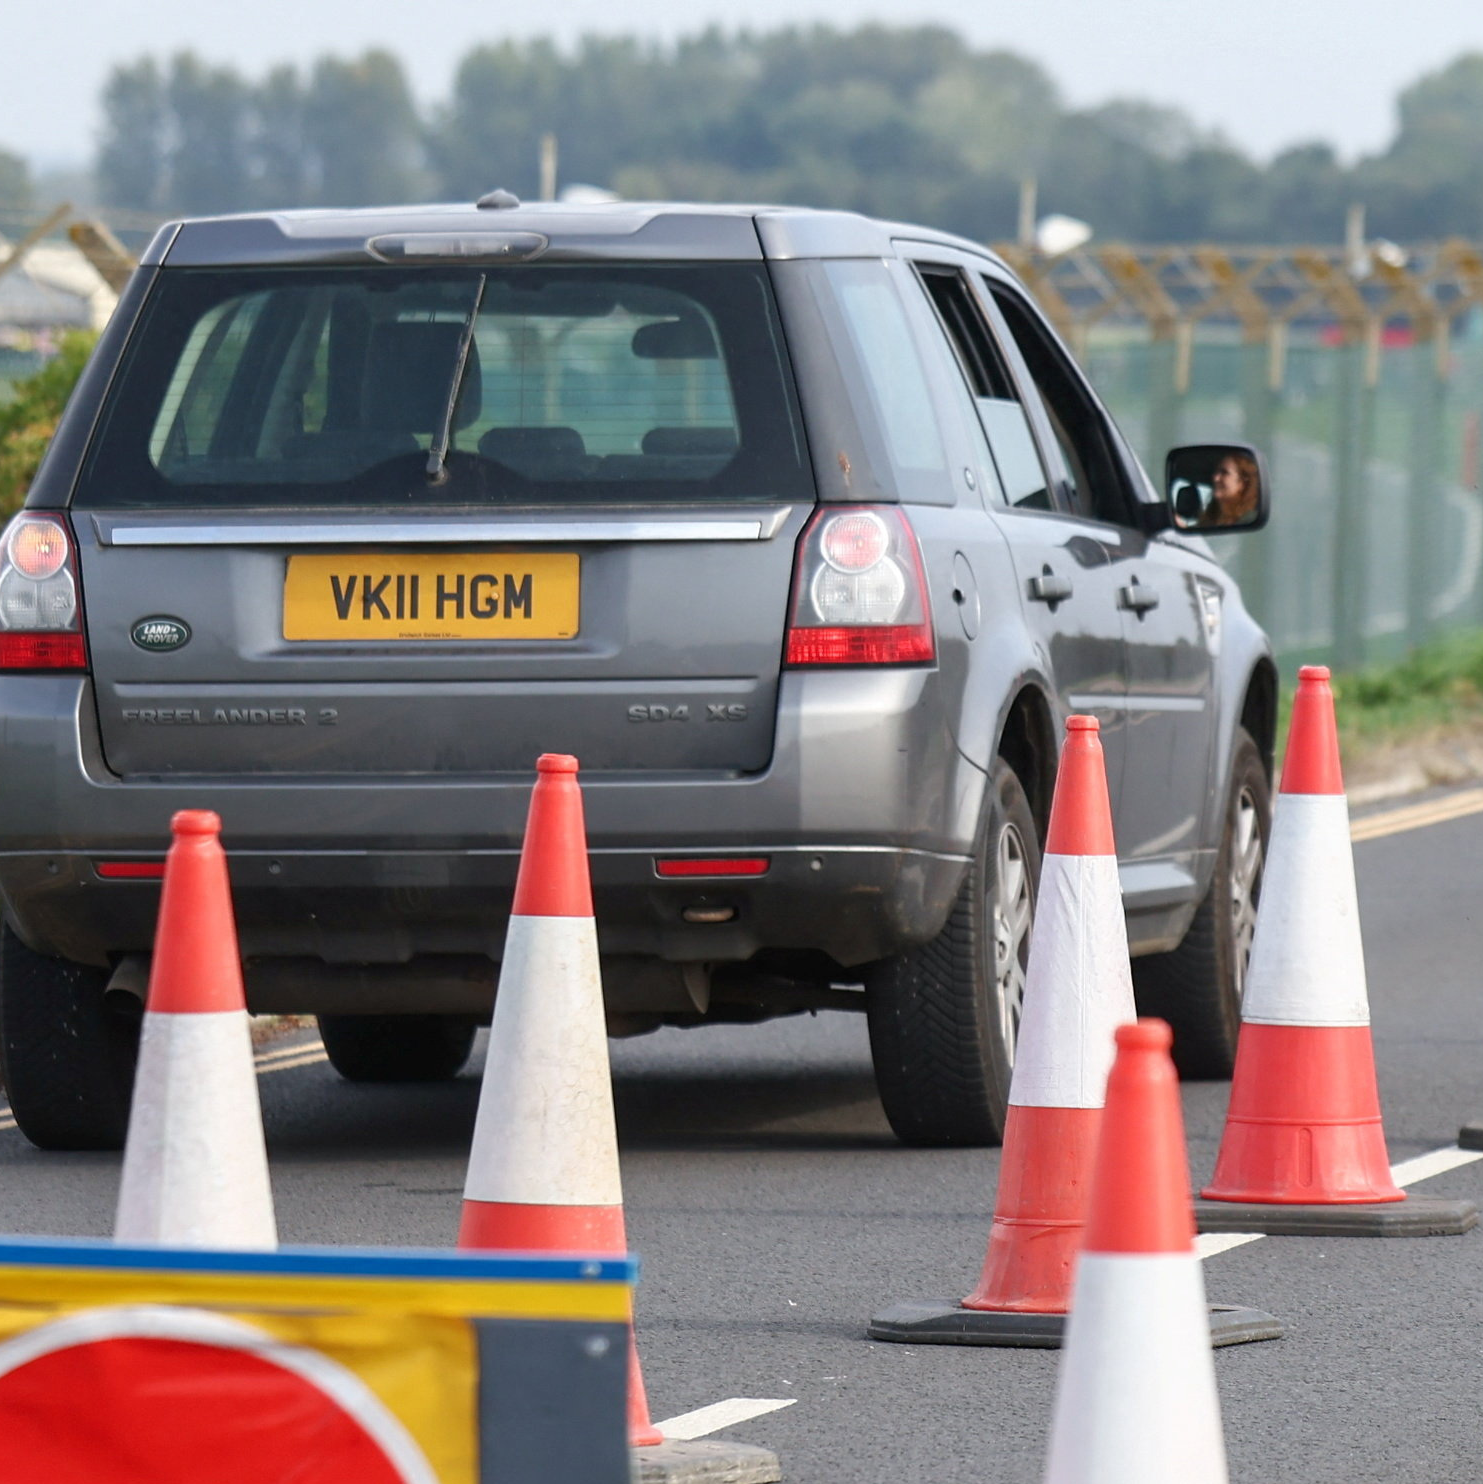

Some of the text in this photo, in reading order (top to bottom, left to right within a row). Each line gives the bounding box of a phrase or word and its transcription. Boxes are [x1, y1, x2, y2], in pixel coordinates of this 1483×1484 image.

[330, 574, 533, 620] VK11 HGM
[144, 624, 171, 634] LAND
[146, 634, 179, 643] ROVER
[122, 708, 338, 726] FREELANDER 2
[628, 704, 748, 722] SD4 XS
